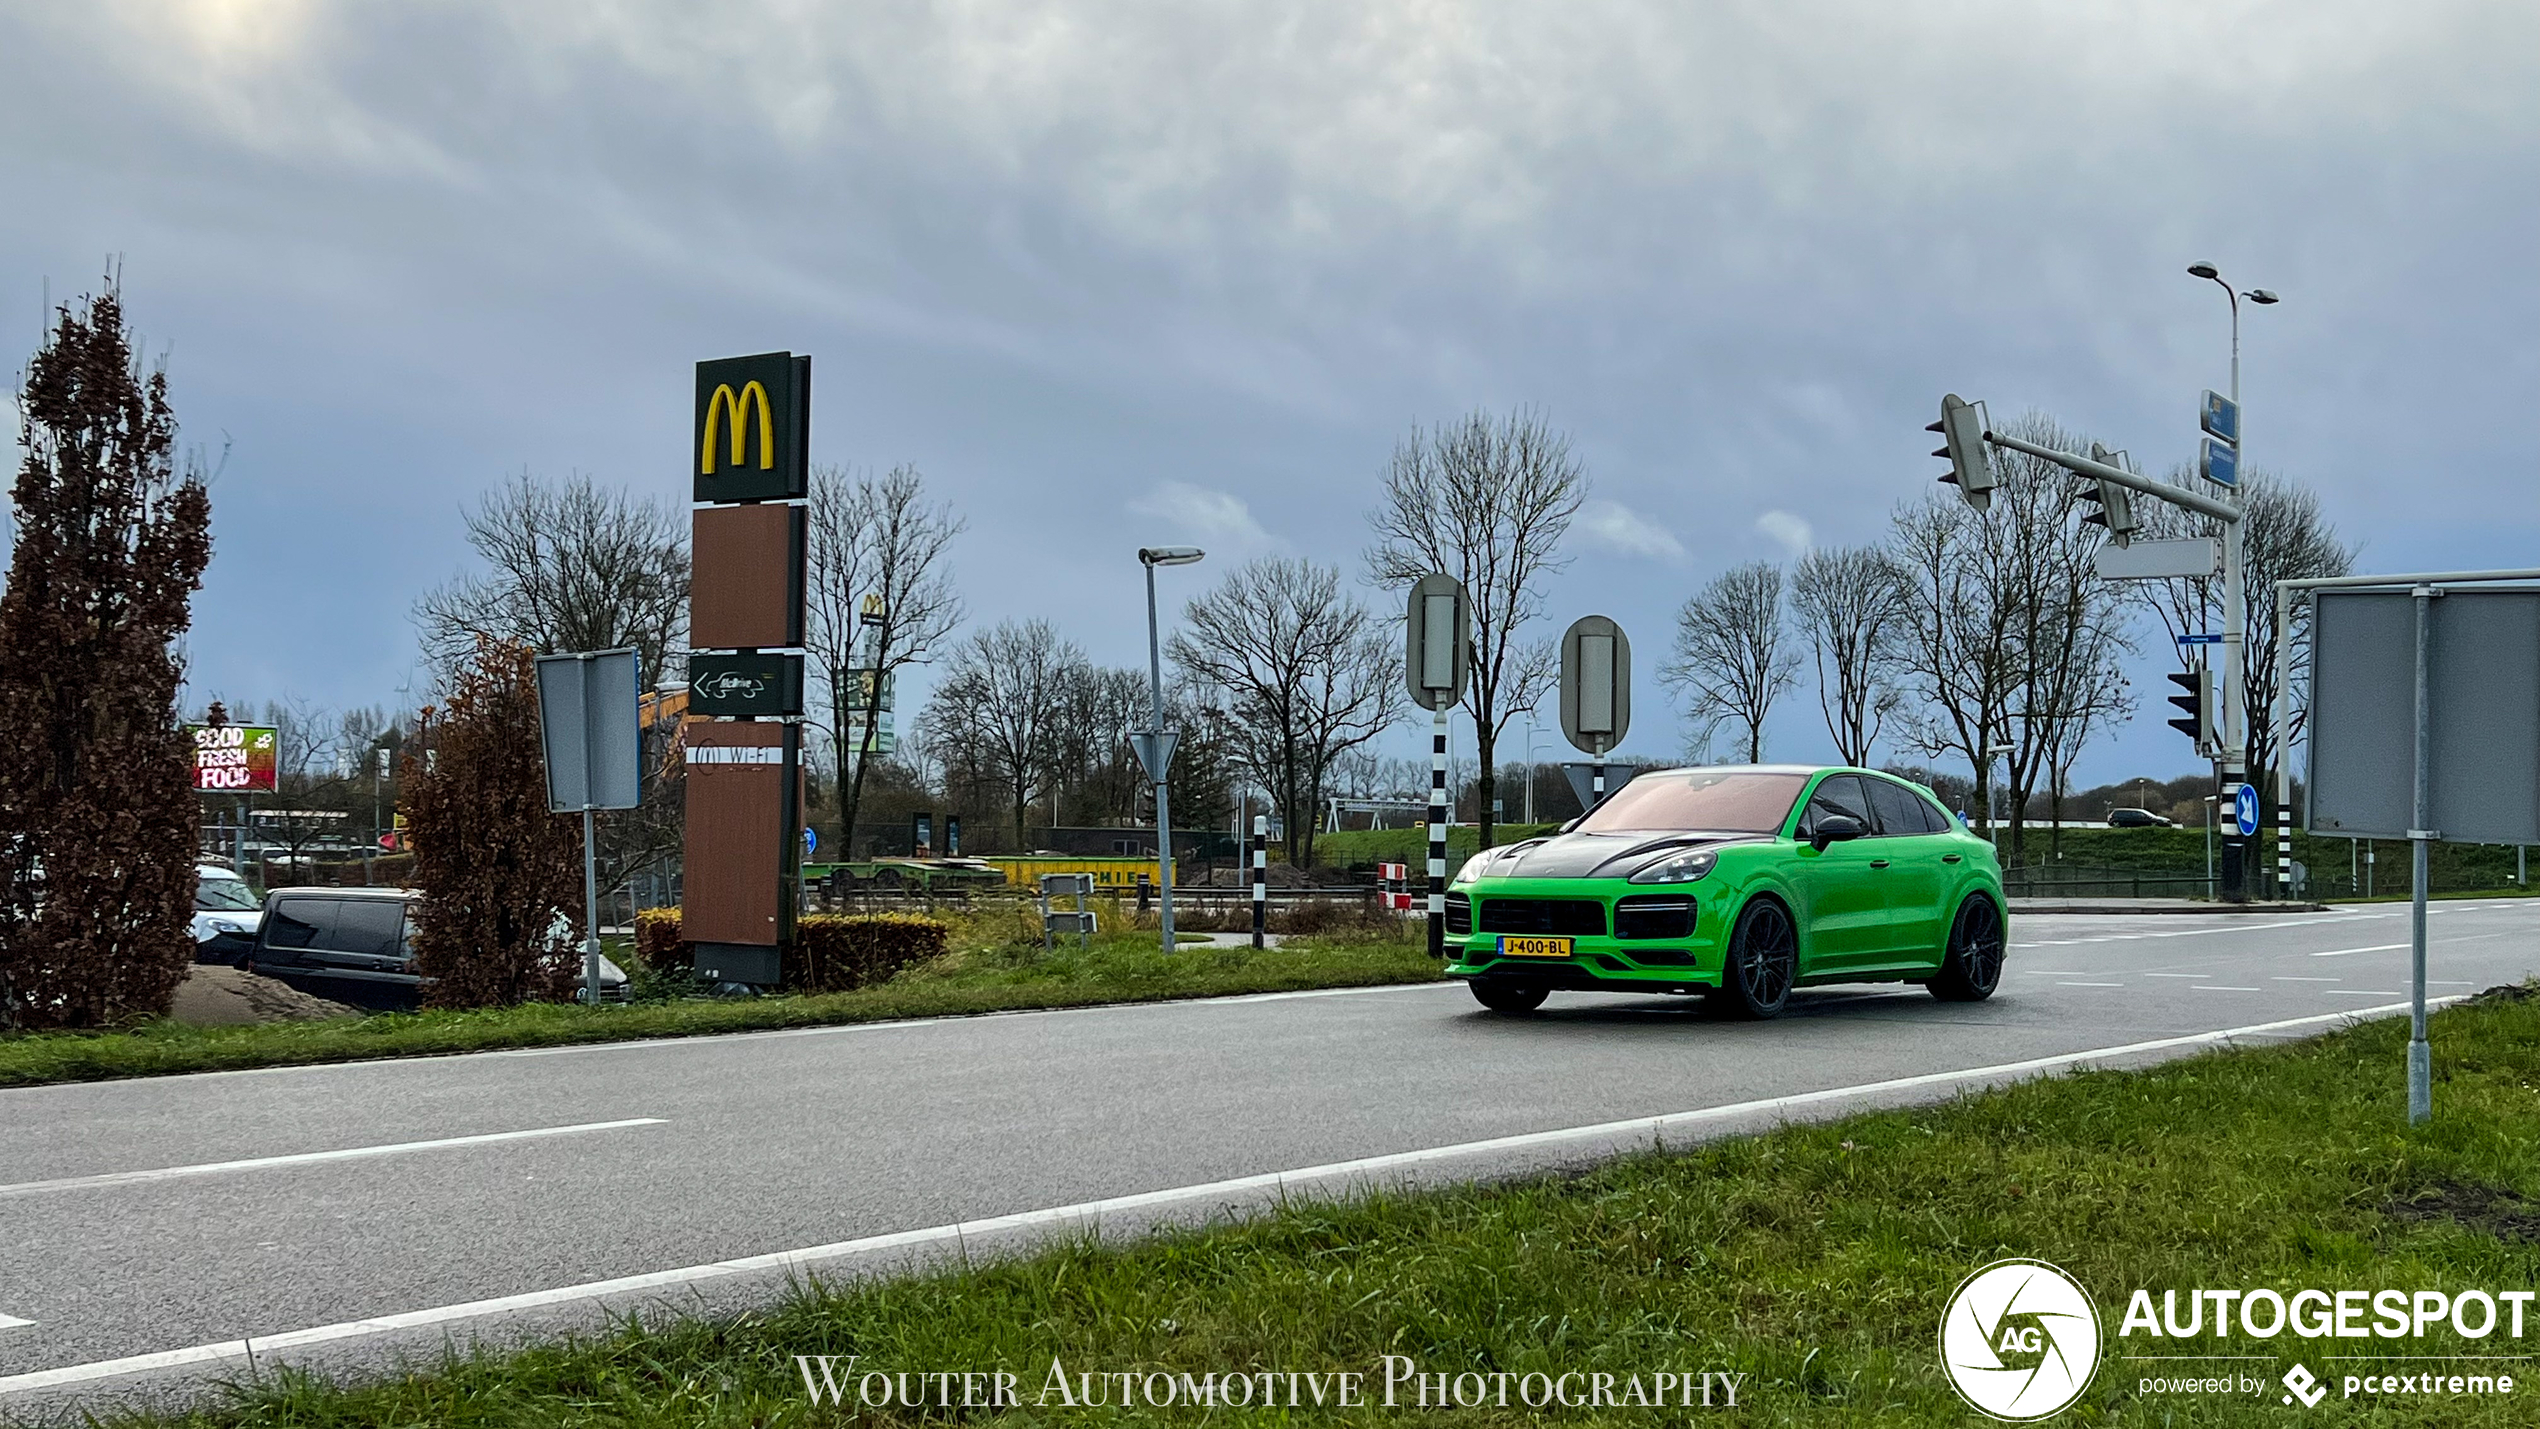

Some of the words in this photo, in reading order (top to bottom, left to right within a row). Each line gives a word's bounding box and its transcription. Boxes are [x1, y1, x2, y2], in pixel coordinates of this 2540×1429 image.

[197, 748, 247, 767] FRESH
[730, 747, 768, 763] Wi-Fi
[201, 767, 250, 788] FOOD
[1508, 940, 1566, 954] J-400-BL
